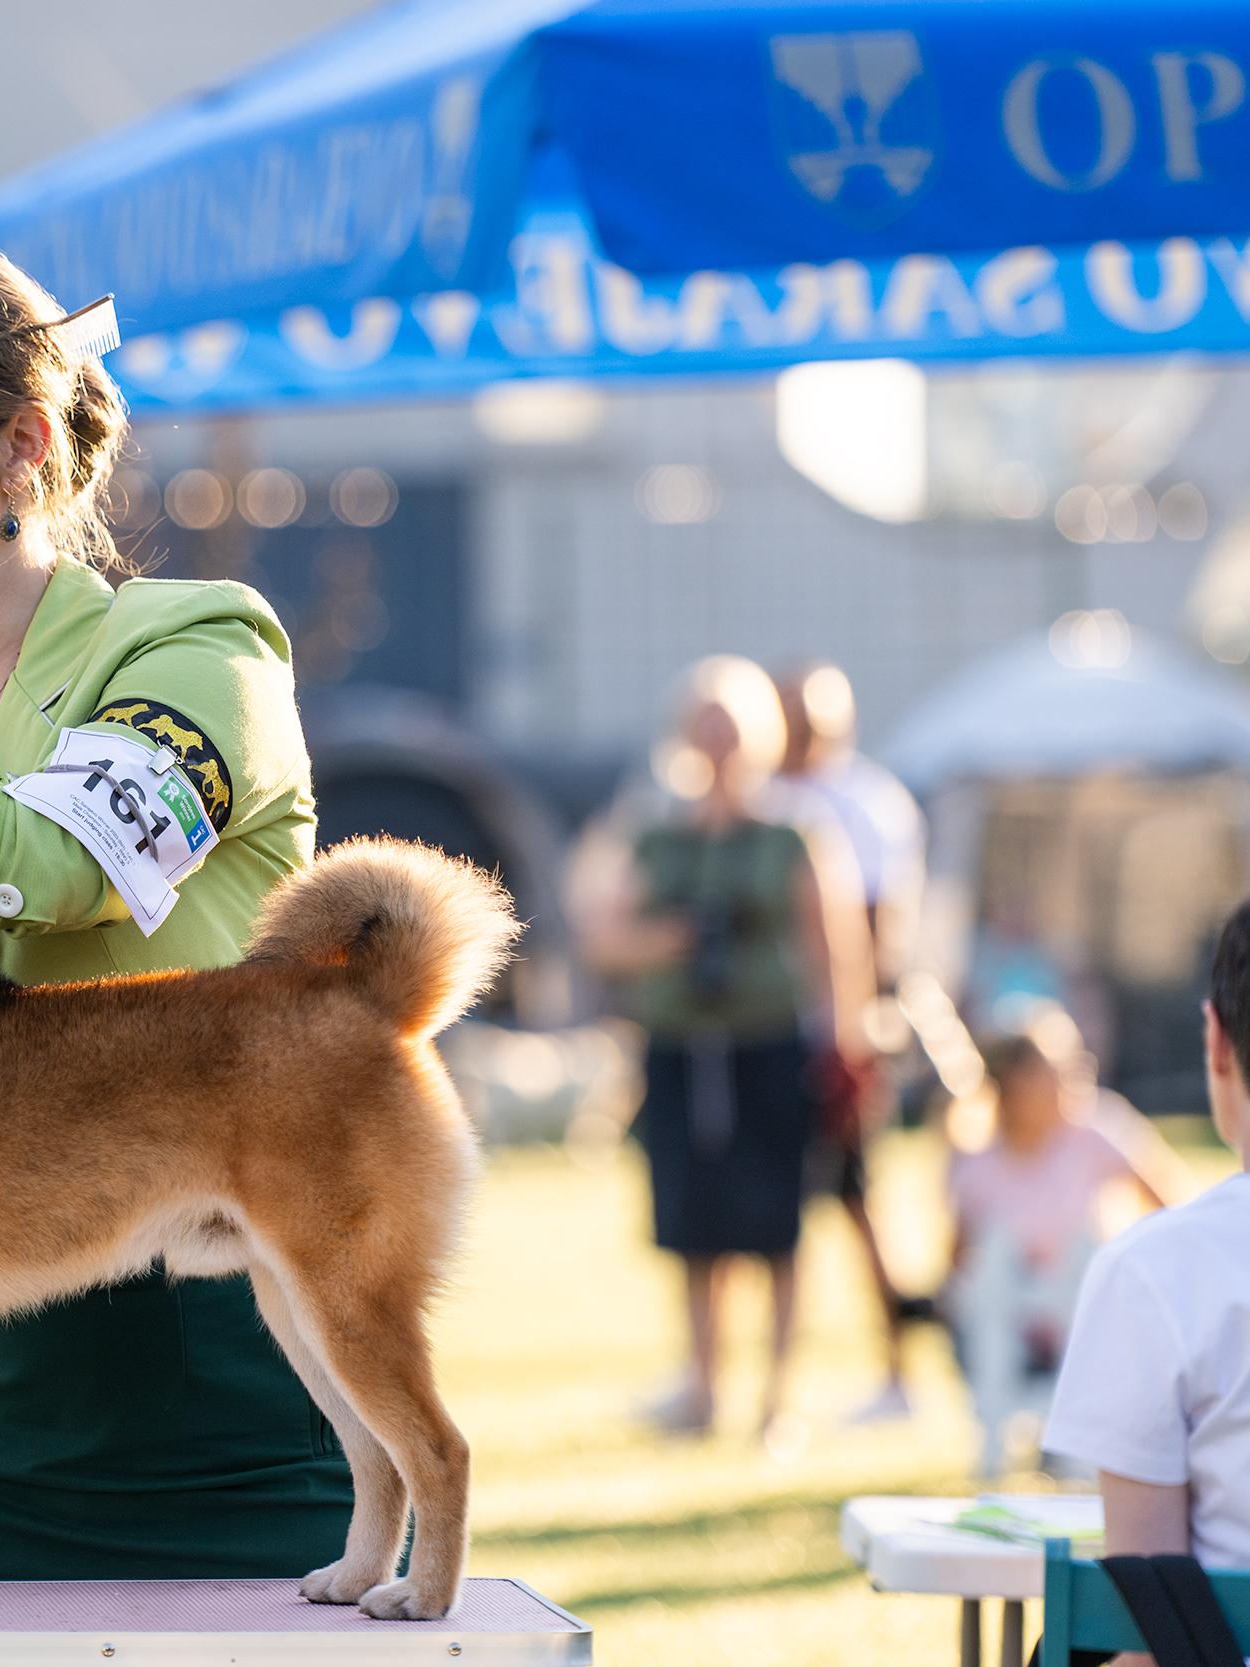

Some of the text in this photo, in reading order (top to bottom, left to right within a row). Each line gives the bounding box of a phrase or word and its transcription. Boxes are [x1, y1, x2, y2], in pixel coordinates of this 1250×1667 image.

[83, 759, 171, 854] 161
[71, 808, 85, 820] Start
[84, 818, 102, 837] judging
[102, 836, 113, 850] class
[191, 829, 201, 846] 1
